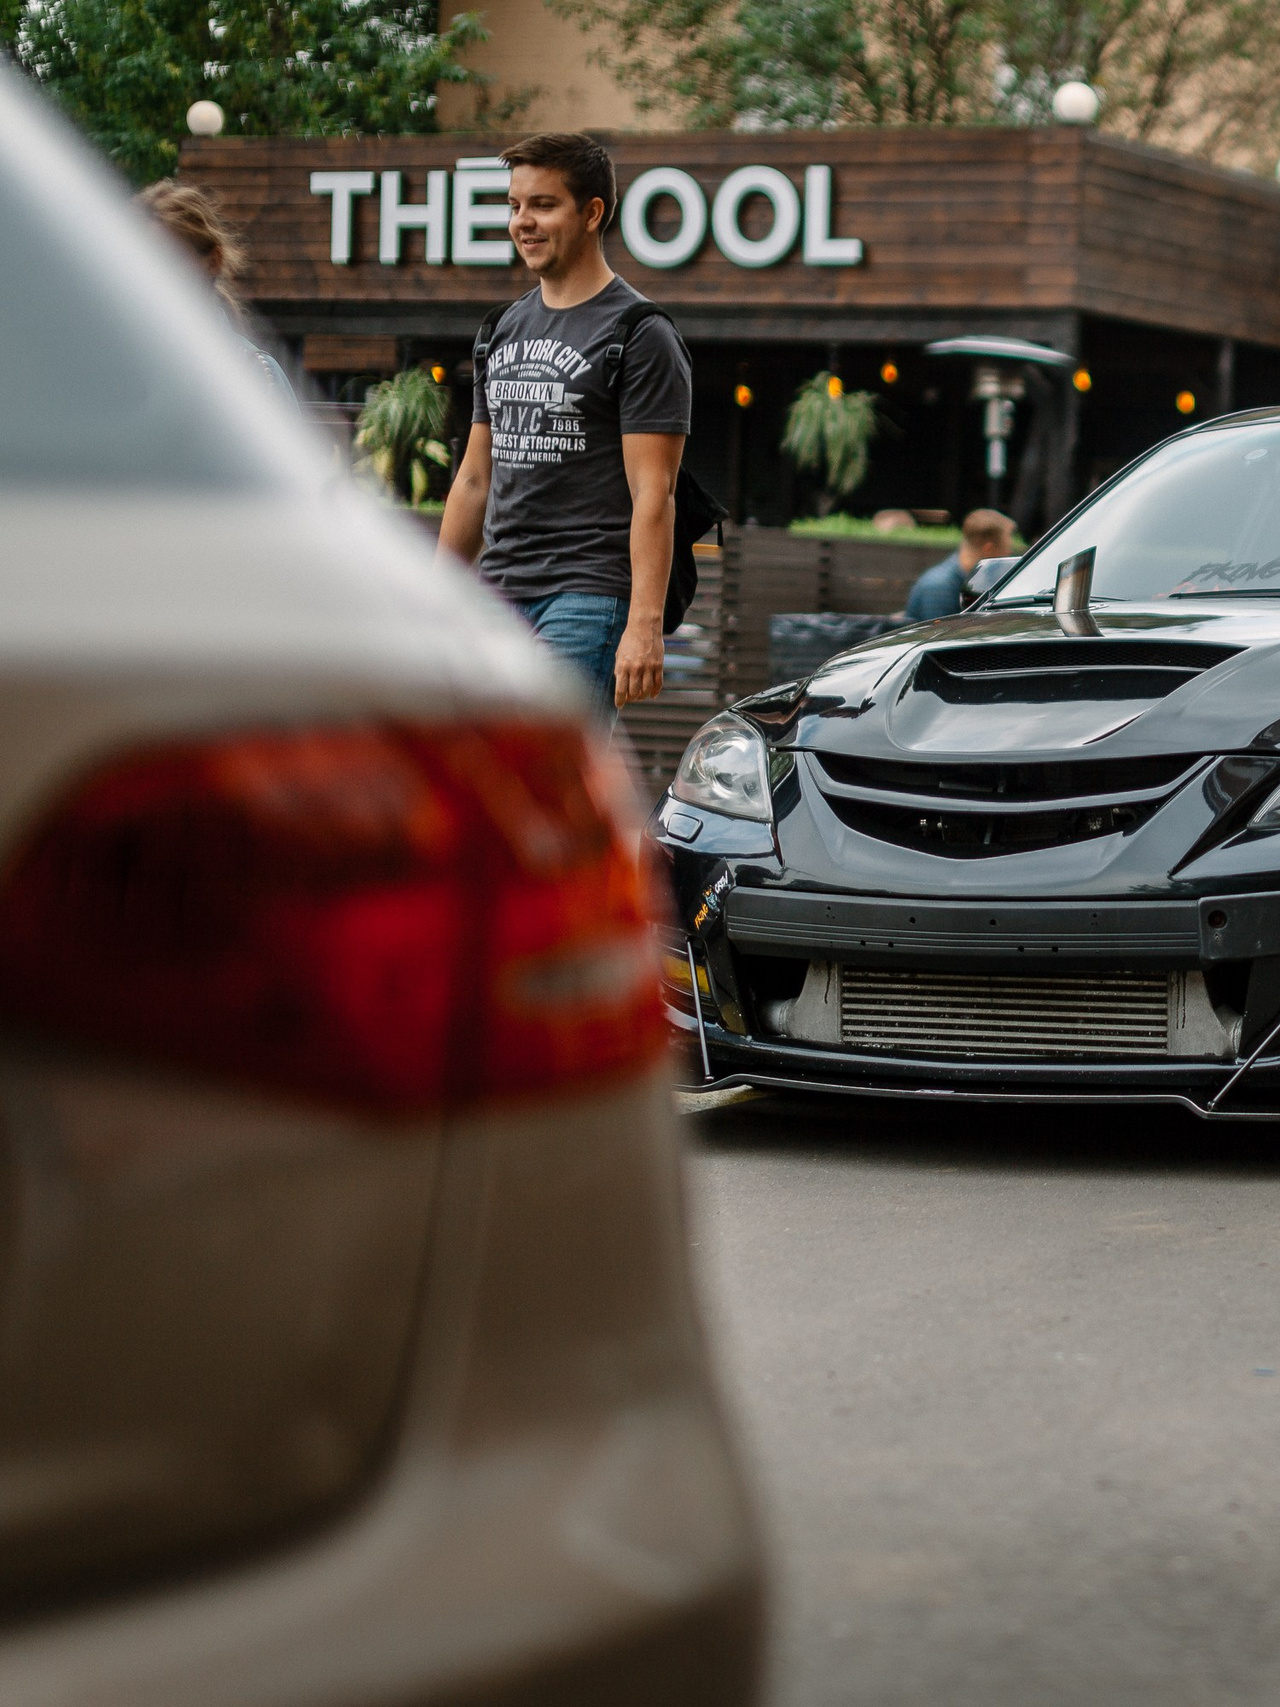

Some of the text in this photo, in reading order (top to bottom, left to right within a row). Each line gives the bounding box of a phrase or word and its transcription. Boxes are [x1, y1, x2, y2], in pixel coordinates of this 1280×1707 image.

[620, 165, 864, 269] OOL
[488, 339, 592, 380] NEW YORK CITY
[495, 382, 554, 401] BROOKLYN
[500, 405, 543, 434] N.Y.C
[519, 435, 586, 452] METROPOLIS
[527, 452, 562, 463] AMERICA
